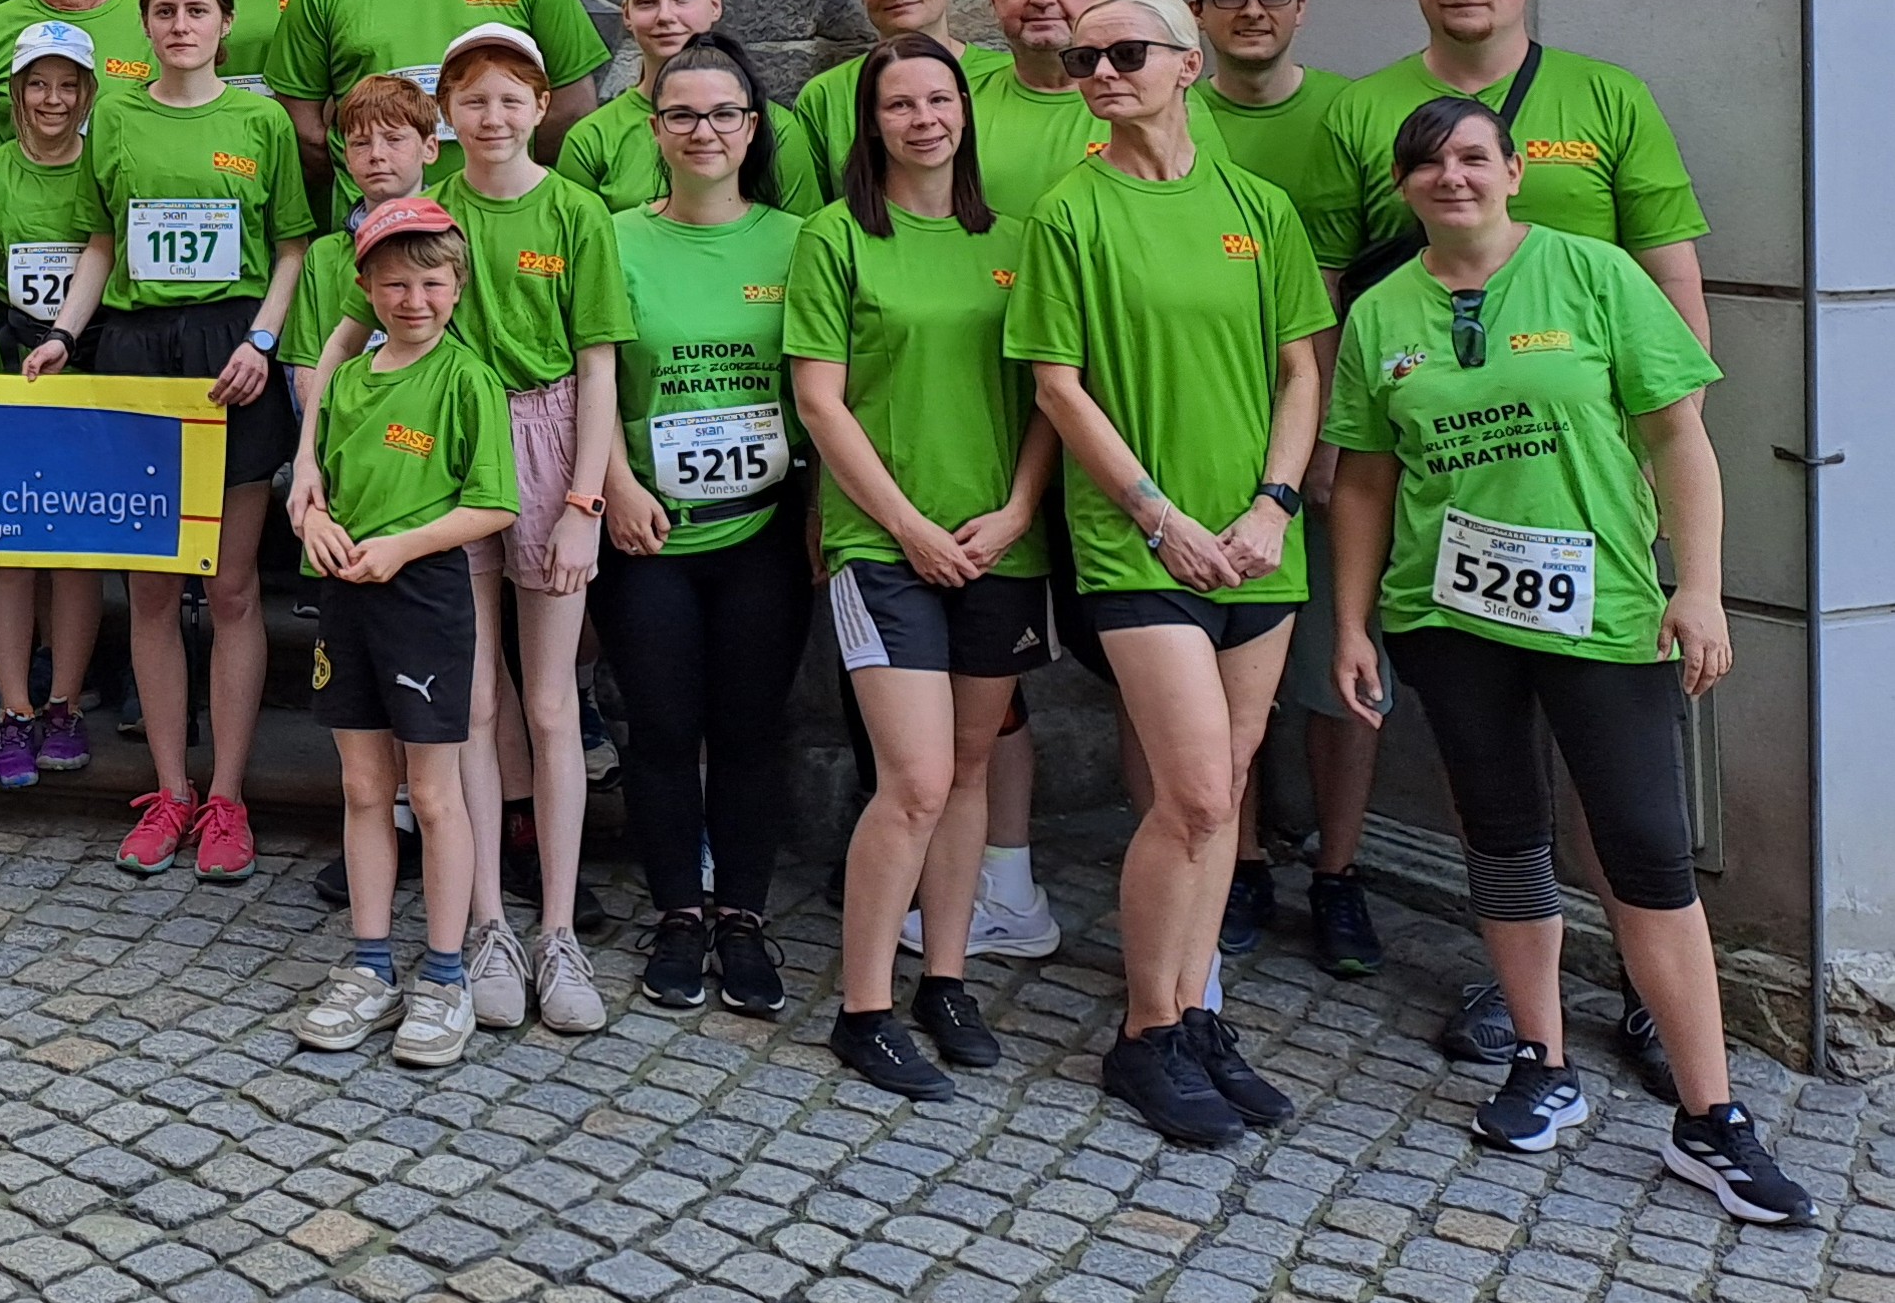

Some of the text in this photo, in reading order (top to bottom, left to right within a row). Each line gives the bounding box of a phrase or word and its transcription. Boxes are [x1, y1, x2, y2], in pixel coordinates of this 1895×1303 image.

[1546, 141, 1599, 161] ASB
[226, 155, 257, 177] ASB
[369, 208, 419, 236] DEKRA
[147, 231, 219, 263] 1137
[43, 256, 67, 264] skan
[533, 254, 565, 274] ASB
[169, 264, 197, 277] Cindy
[1527, 331, 1572, 348] ASB
[672, 343, 756, 360] EUROPA
[660, 376, 771, 396] MARATHON
[1432, 401, 1534, 435] EUROPA
[399, 429, 435, 453] ASB
[695, 426, 724, 438] skan
[677, 443, 768, 484] 5215
[1426, 437, 1558, 475] MARATHON
[700, 483, 748, 495] Vanessa
[1490, 538, 1526, 554] skan
[1452, 552, 1575, 613] 5289
[1483, 600, 1540, 625] Stefanie
